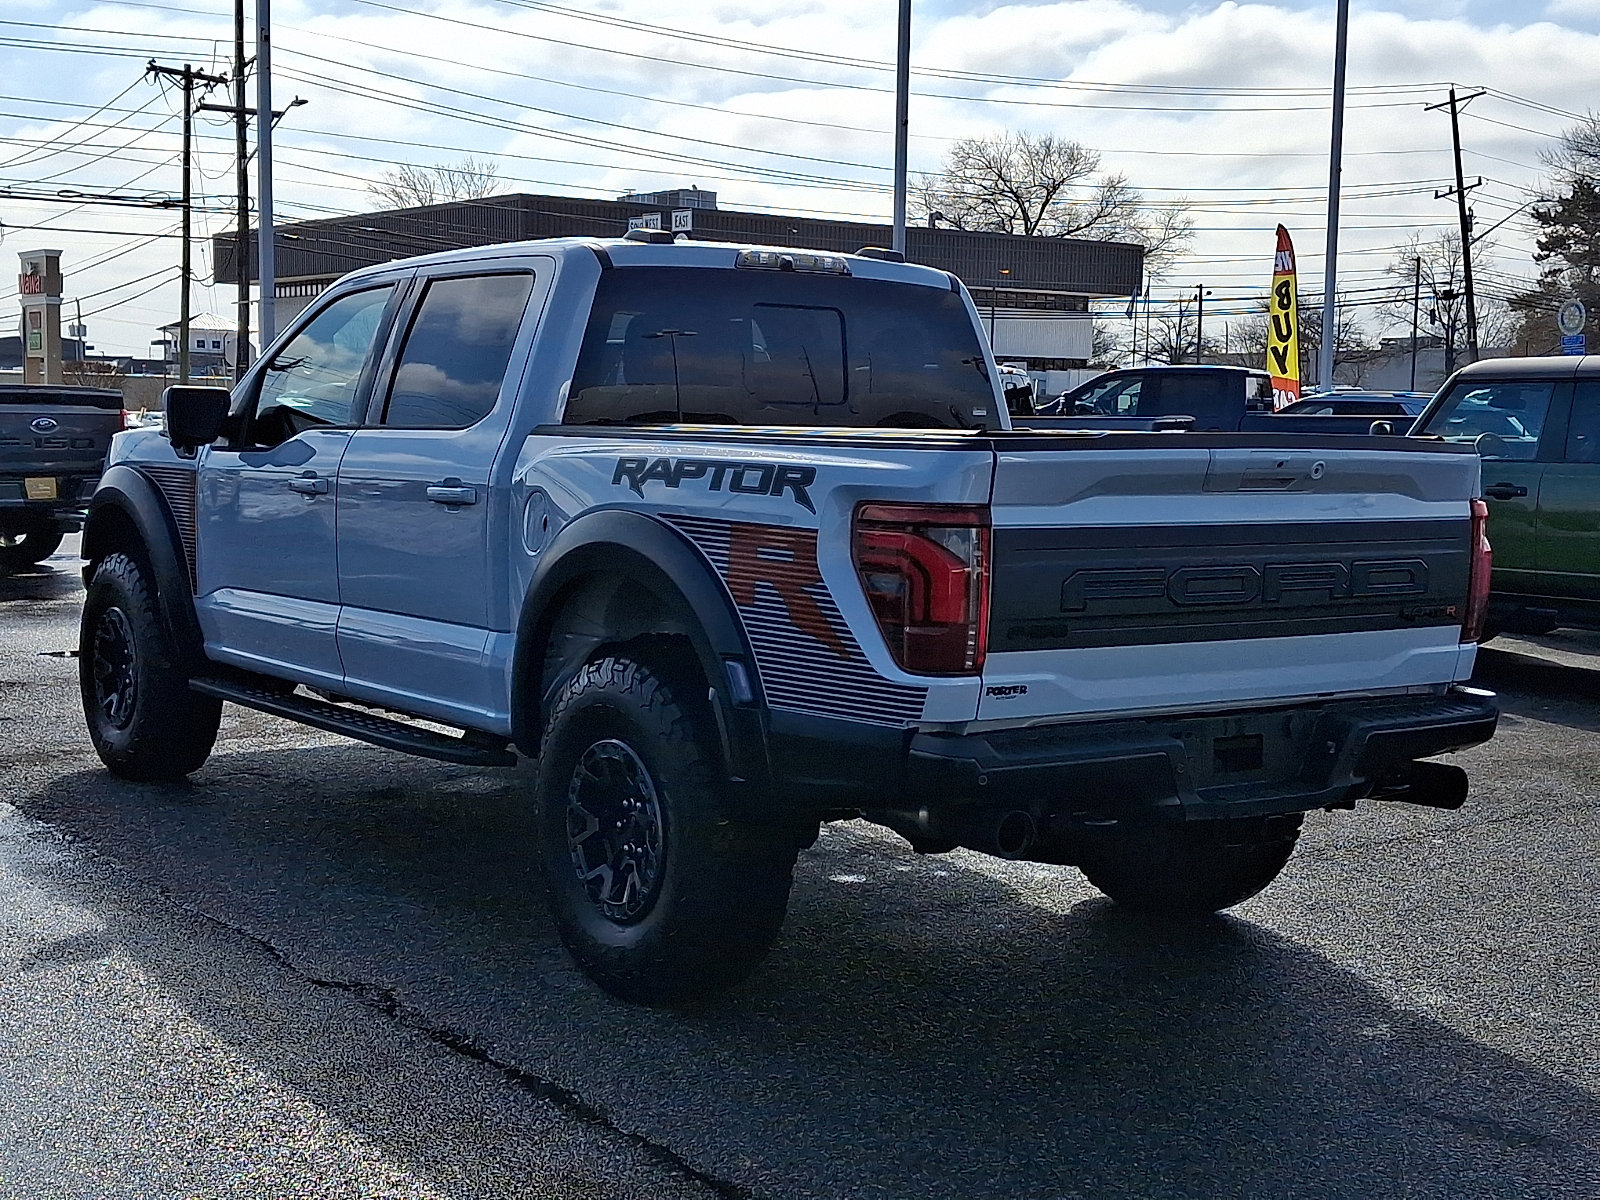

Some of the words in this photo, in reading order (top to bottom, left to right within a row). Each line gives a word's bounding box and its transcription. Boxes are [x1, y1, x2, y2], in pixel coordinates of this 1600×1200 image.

[644, 217, 659, 230] WEST
[674, 214, 689, 228] EAST
[610, 456, 818, 516] RAPTOR
[1060, 558, 1430, 613] FORD
[985, 684, 1028, 697] PORTER
